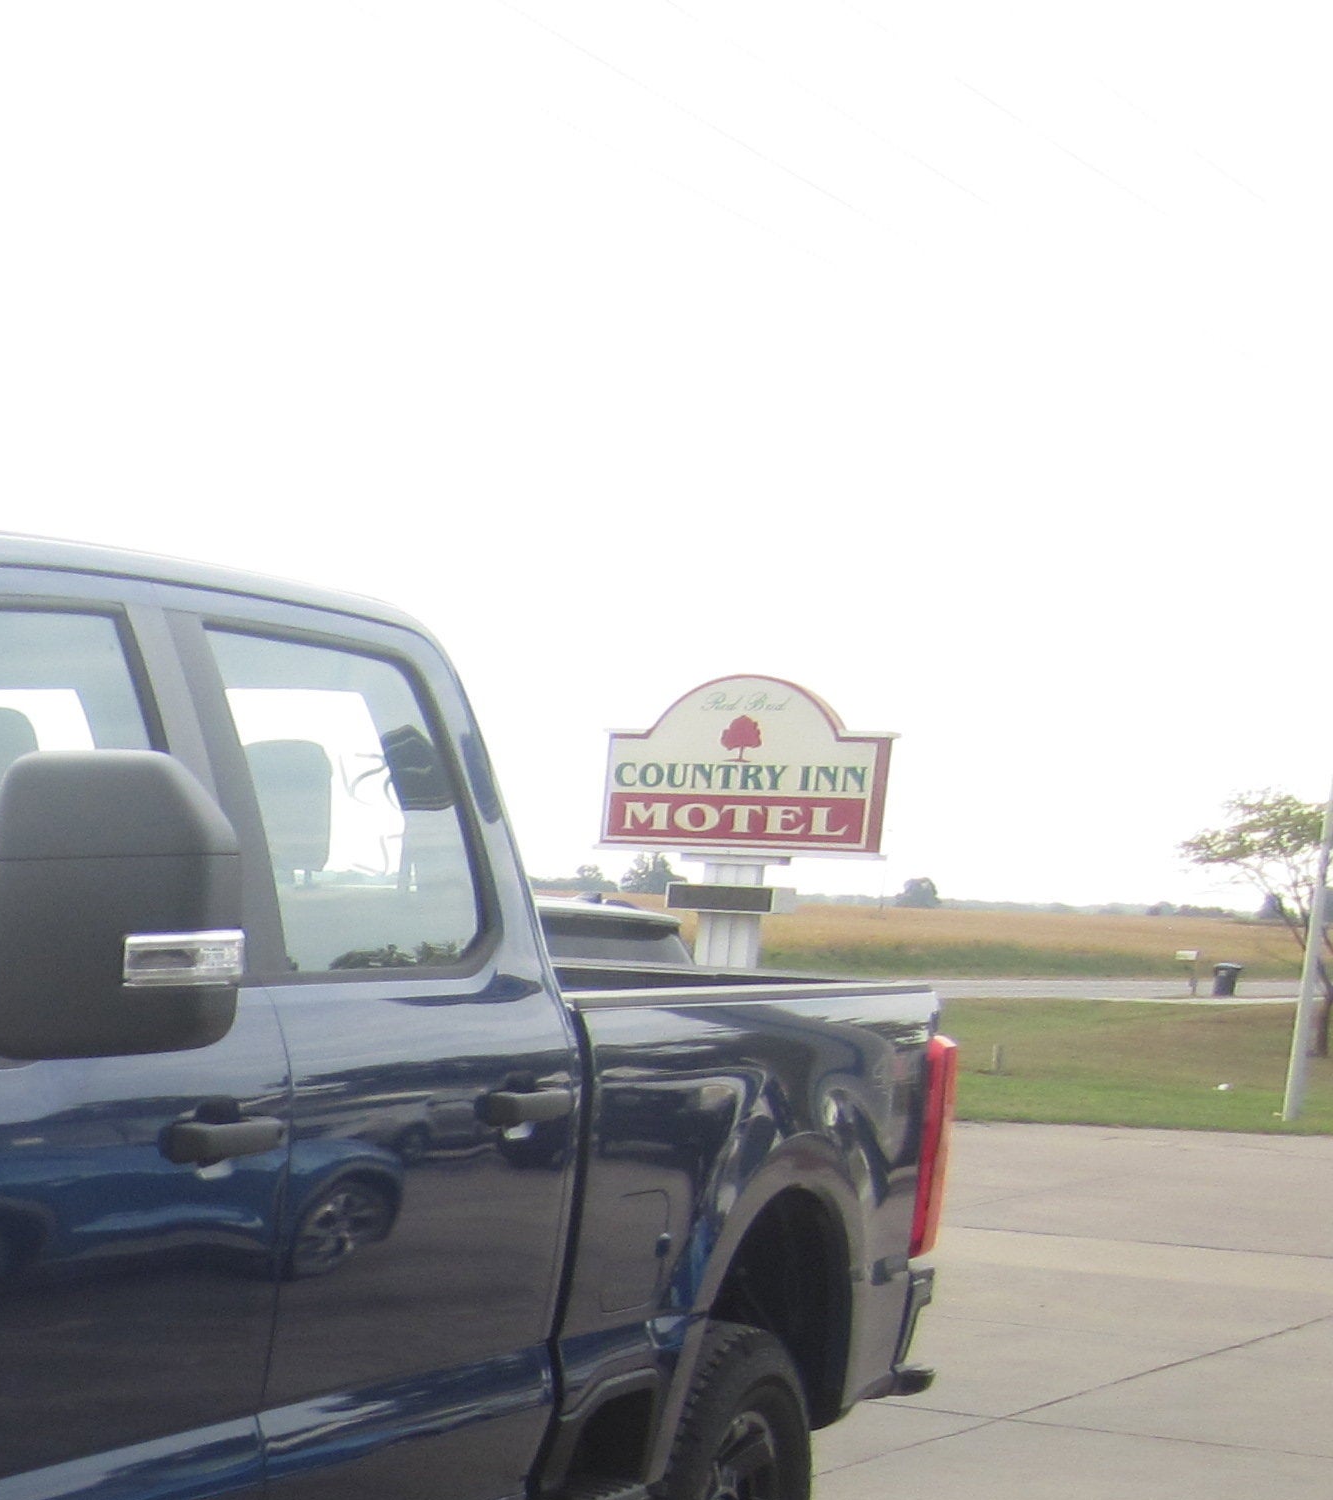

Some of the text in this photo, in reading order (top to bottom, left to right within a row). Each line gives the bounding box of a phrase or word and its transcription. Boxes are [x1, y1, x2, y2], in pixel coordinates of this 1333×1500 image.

[614, 762, 868, 792] COUNTRY INN
[622, 801, 849, 836] MOTEL
